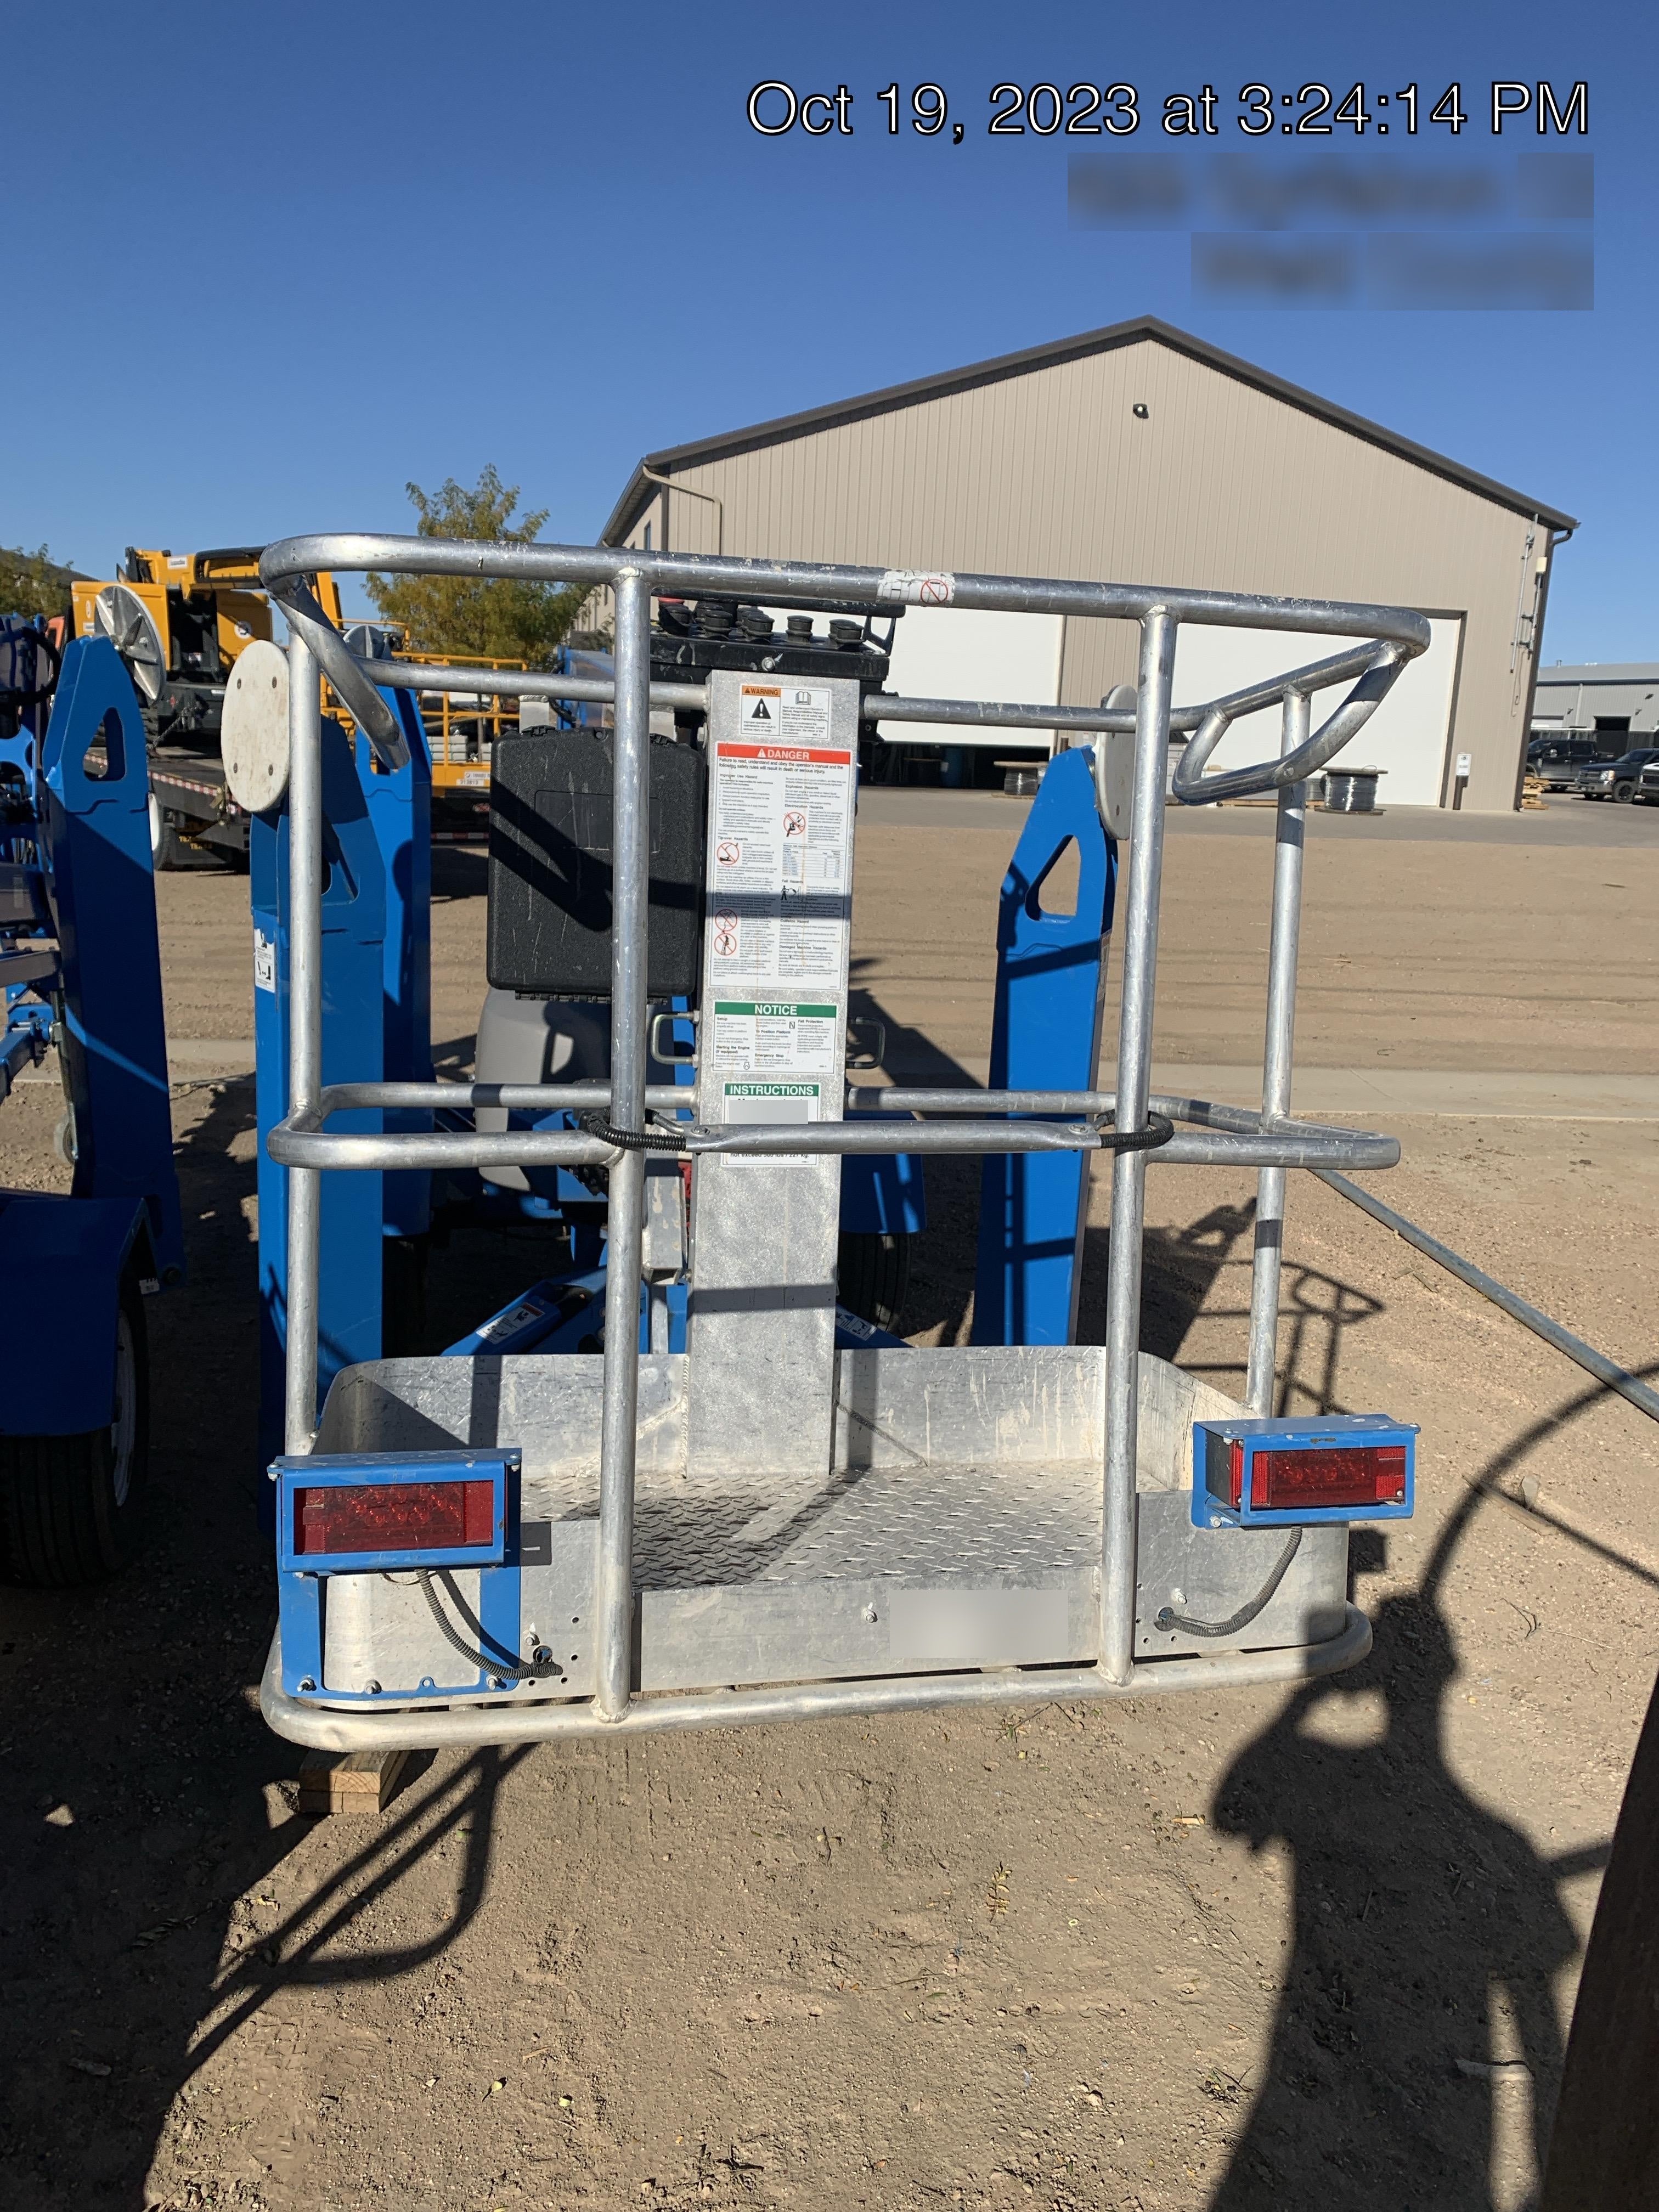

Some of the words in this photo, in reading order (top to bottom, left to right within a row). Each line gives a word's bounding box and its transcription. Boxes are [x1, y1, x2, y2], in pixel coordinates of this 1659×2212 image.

[768, 749, 810, 760] DANGER
[755, 1005, 797, 1015] NOTICE
[730, 1085, 814, 1095] INSTRUCTIONS
